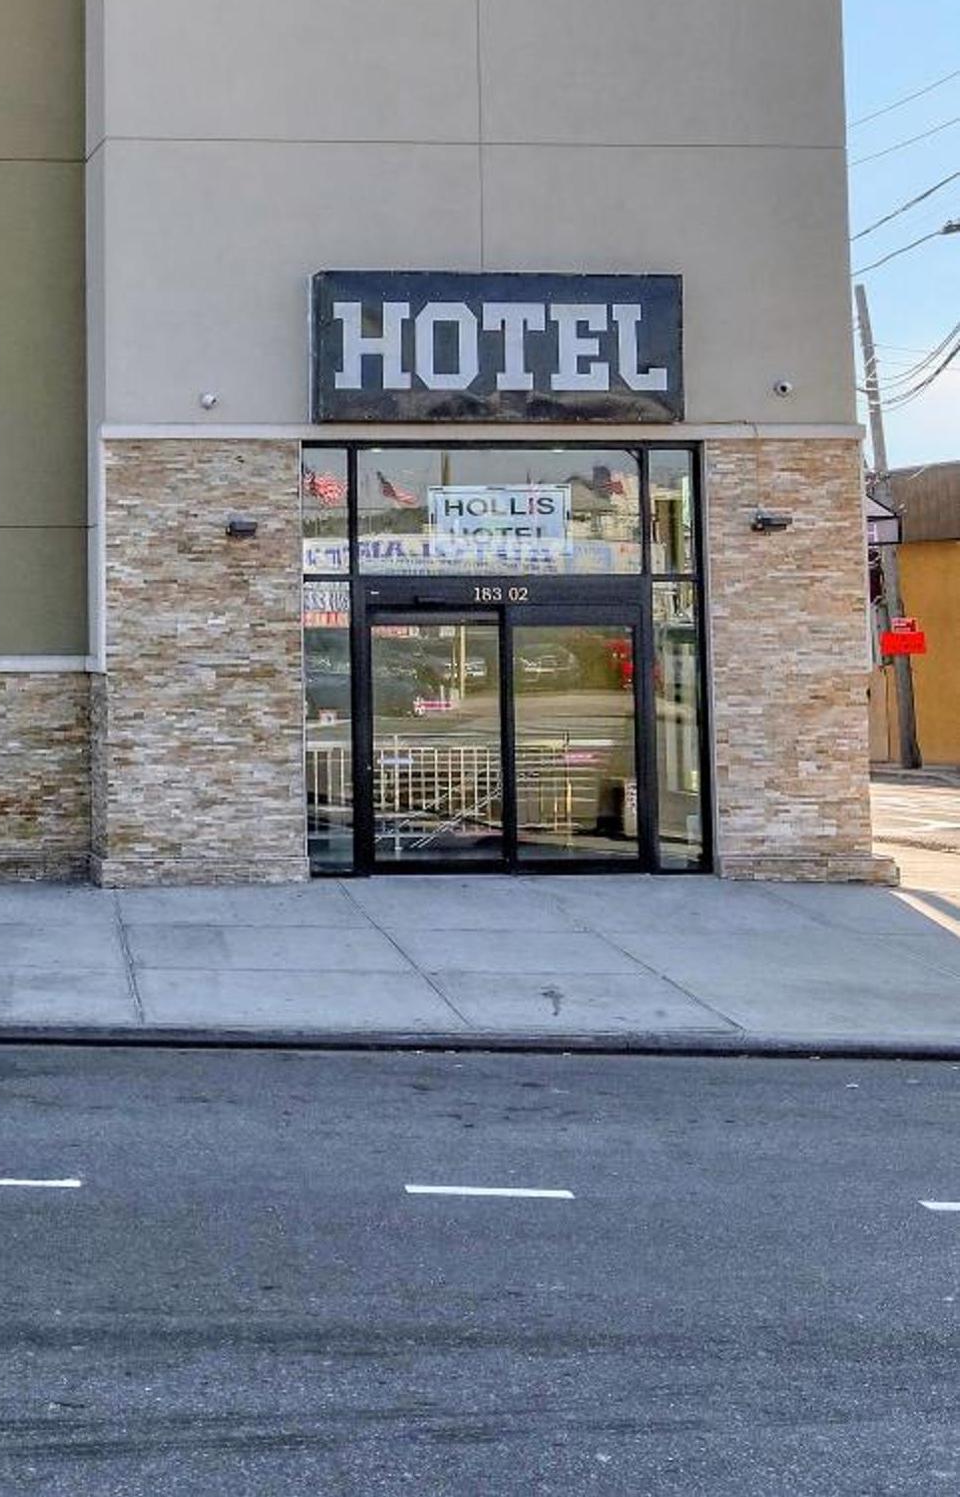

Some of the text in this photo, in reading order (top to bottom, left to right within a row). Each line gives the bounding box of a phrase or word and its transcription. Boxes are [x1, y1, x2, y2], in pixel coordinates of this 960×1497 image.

[333, 302, 668, 391] HOTEL
[444, 497, 555, 517] HOLLIS
[474, 587, 528, 601] 183 02
